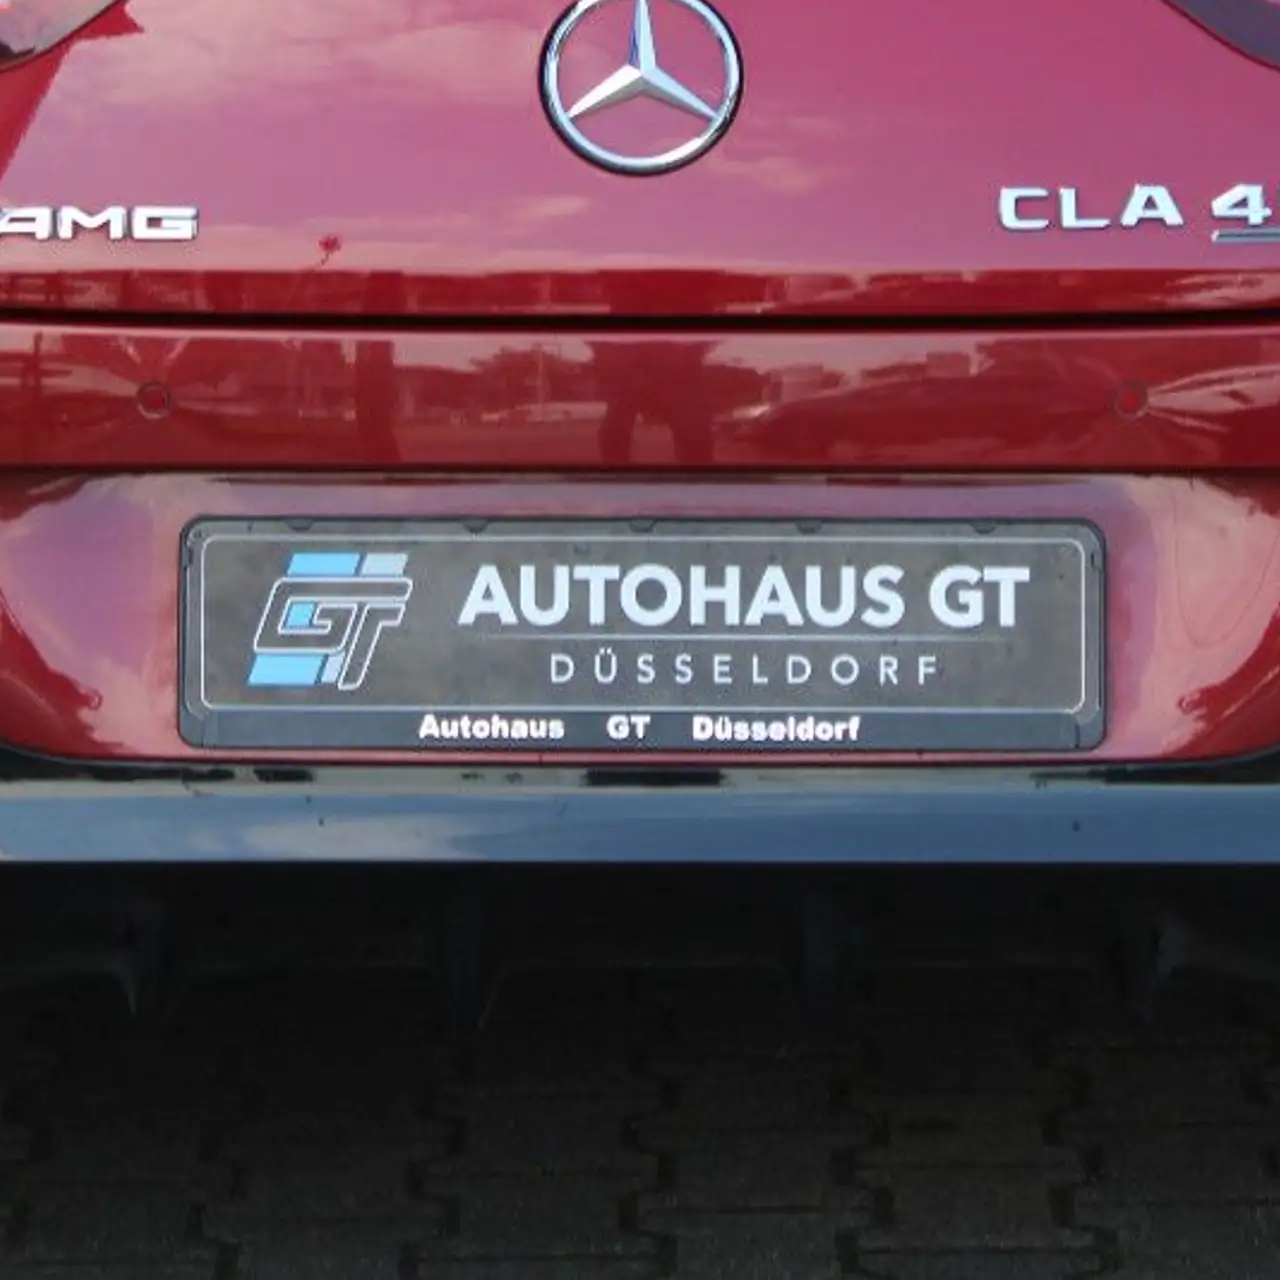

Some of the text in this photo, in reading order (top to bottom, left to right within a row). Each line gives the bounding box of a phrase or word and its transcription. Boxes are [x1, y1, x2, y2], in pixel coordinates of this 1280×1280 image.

[998, 183, 1184, 229] CLA
[458, 563, 1031, 629] AUTOHAUS GT
[252, 575, 414, 691] GT
[550, 647, 938, 686] DÜSSELDORF
[418, 714, 862, 742] Autohaus GT Düsseldorf
